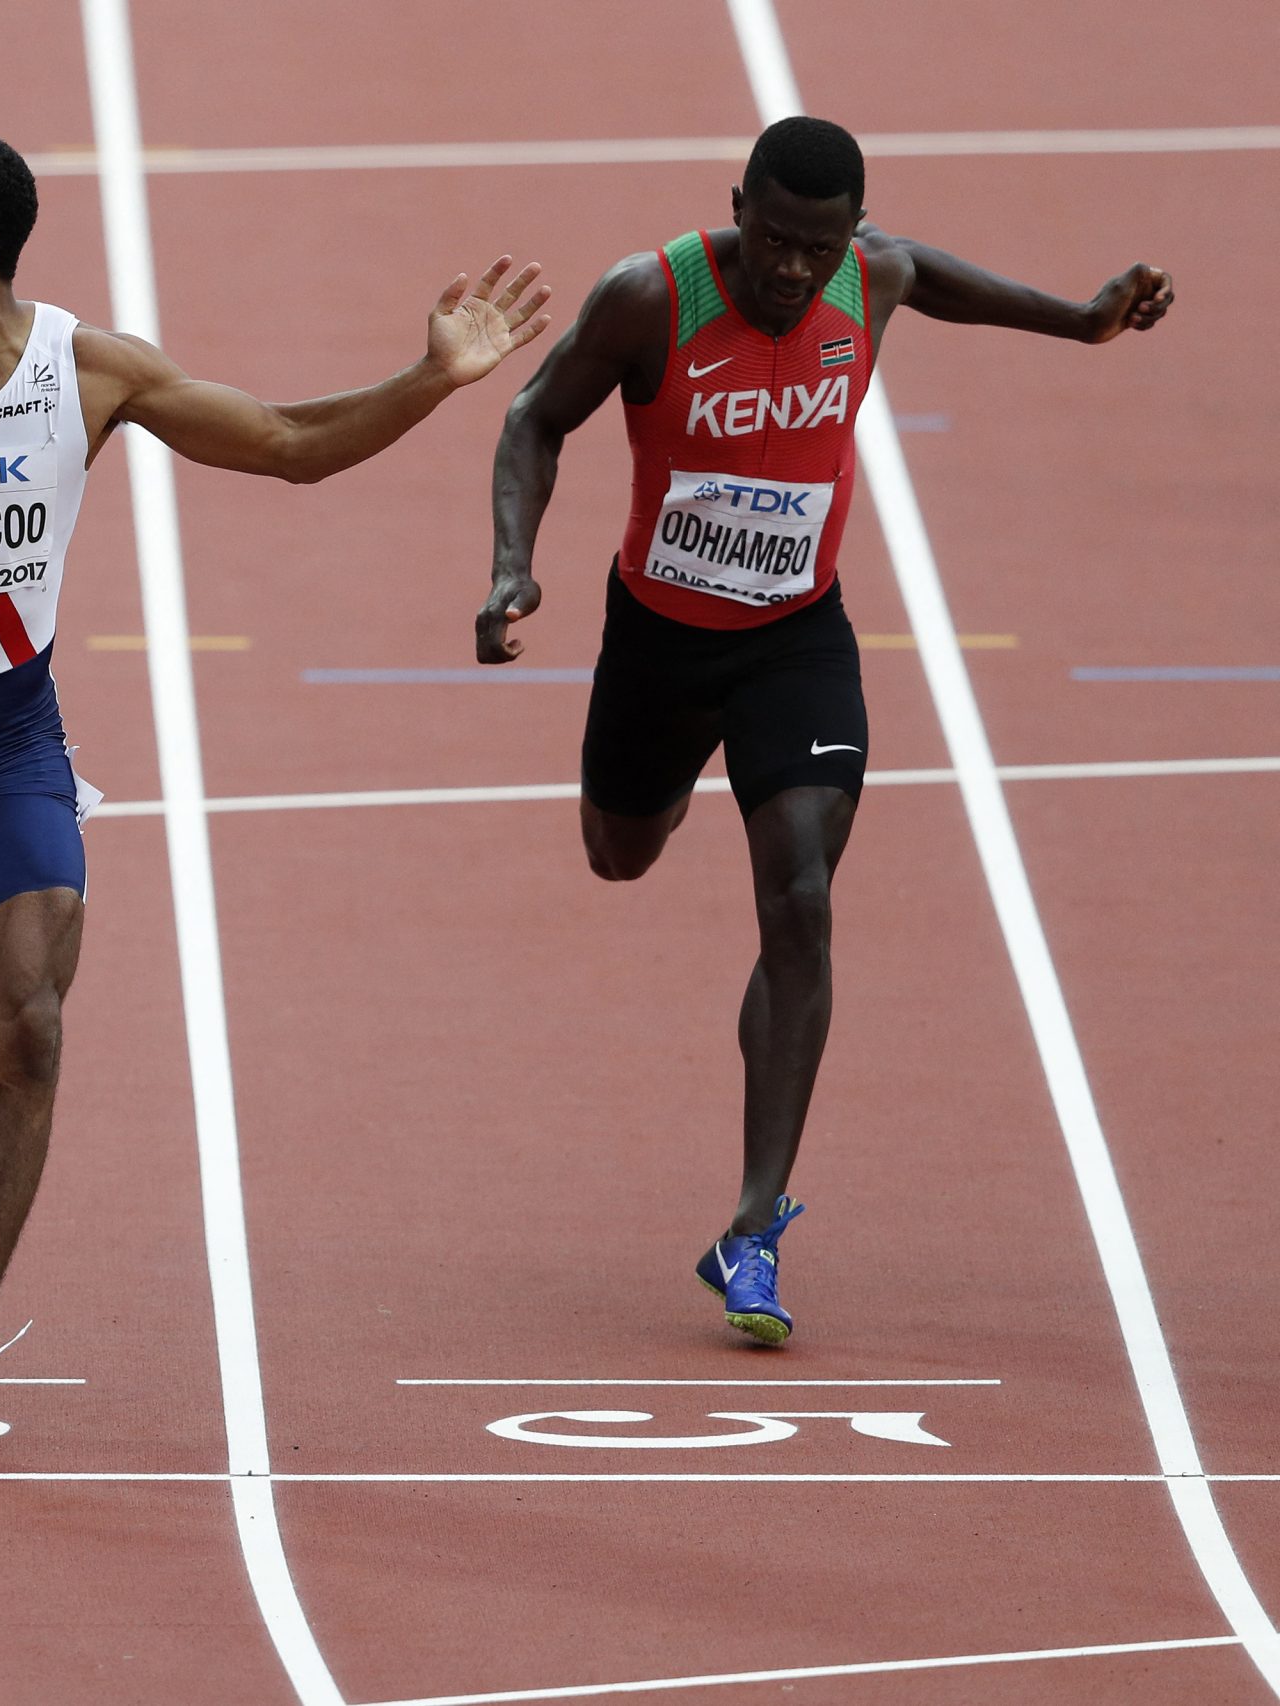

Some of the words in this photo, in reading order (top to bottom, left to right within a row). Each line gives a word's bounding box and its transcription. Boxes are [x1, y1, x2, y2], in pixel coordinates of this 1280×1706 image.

[686, 375, 850, 438] KENYA
[723, 483, 811, 517] TDK
[661, 510, 812, 576] ODHIAMBO
[0, 561, 48, 586] 2017
[485, 1410, 953, 1448] 5
